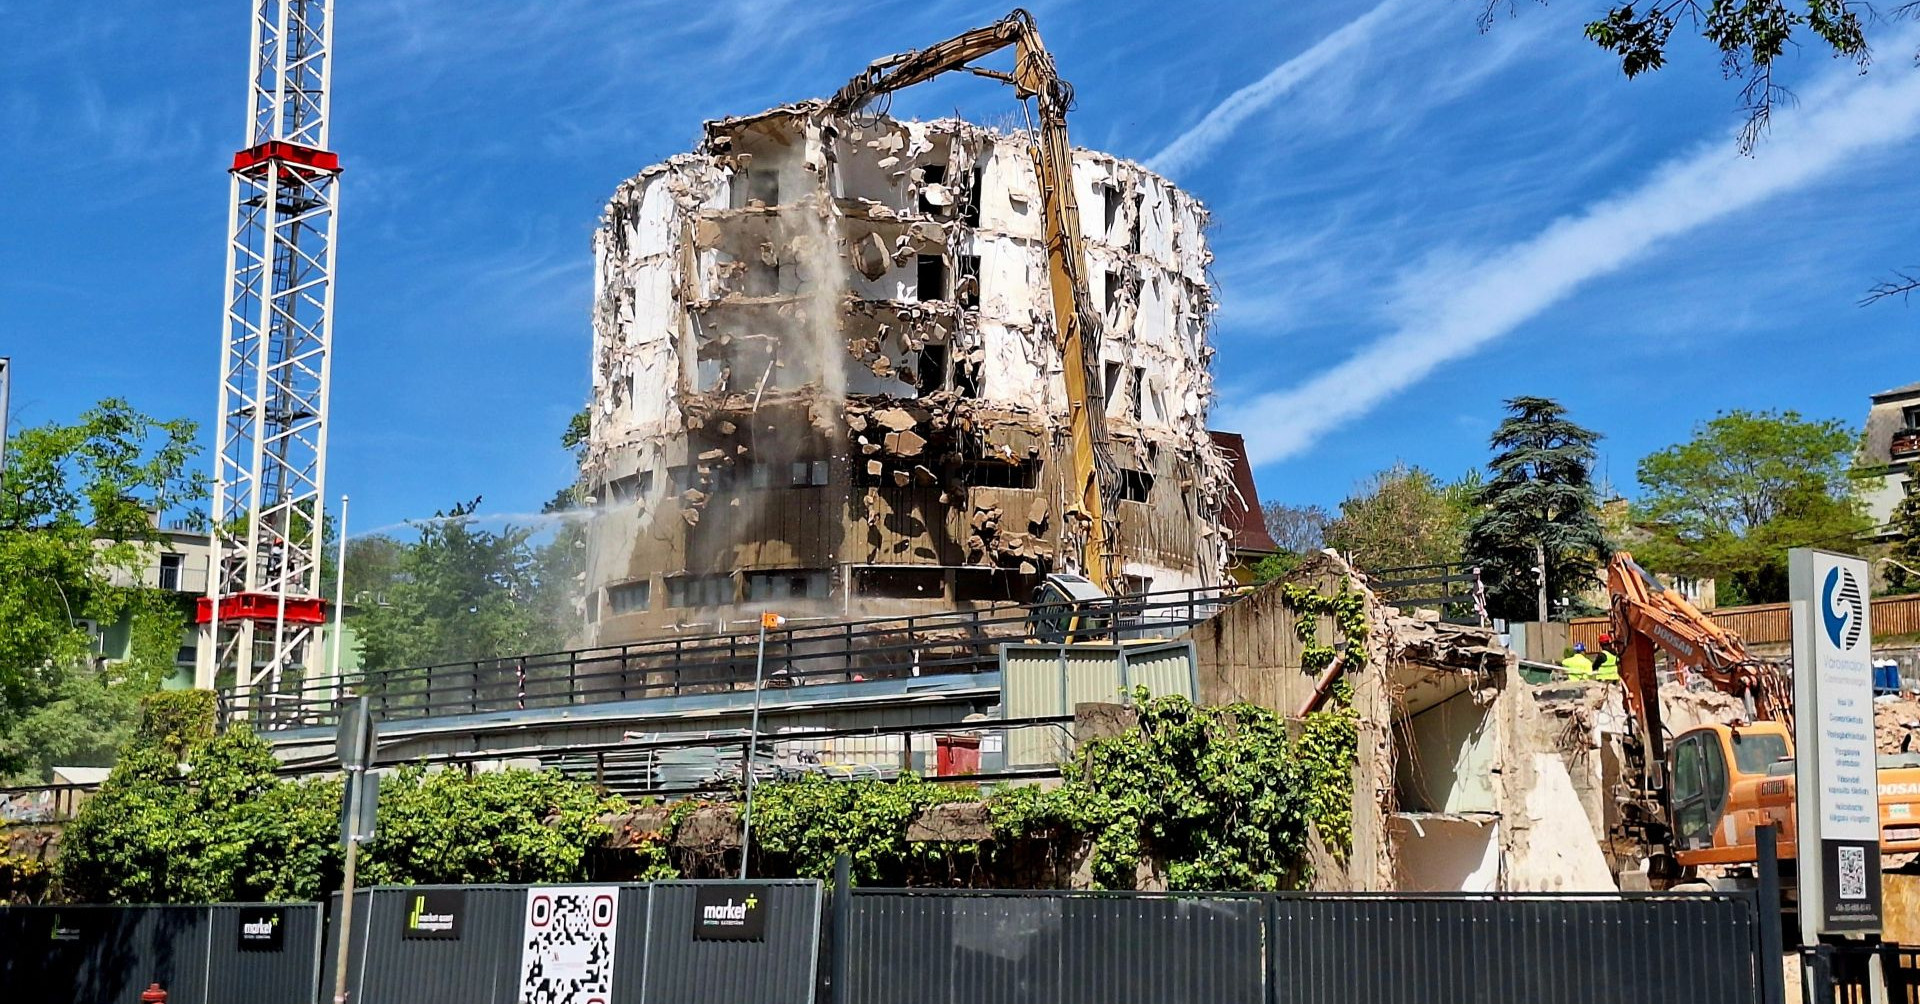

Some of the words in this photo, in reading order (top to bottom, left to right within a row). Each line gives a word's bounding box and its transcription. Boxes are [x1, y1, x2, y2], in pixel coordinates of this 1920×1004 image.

[1653, 624, 1693, 656] DOOSAN
[1877, 783, 1920, 796] OOSA
[703, 898, 747, 920] market
